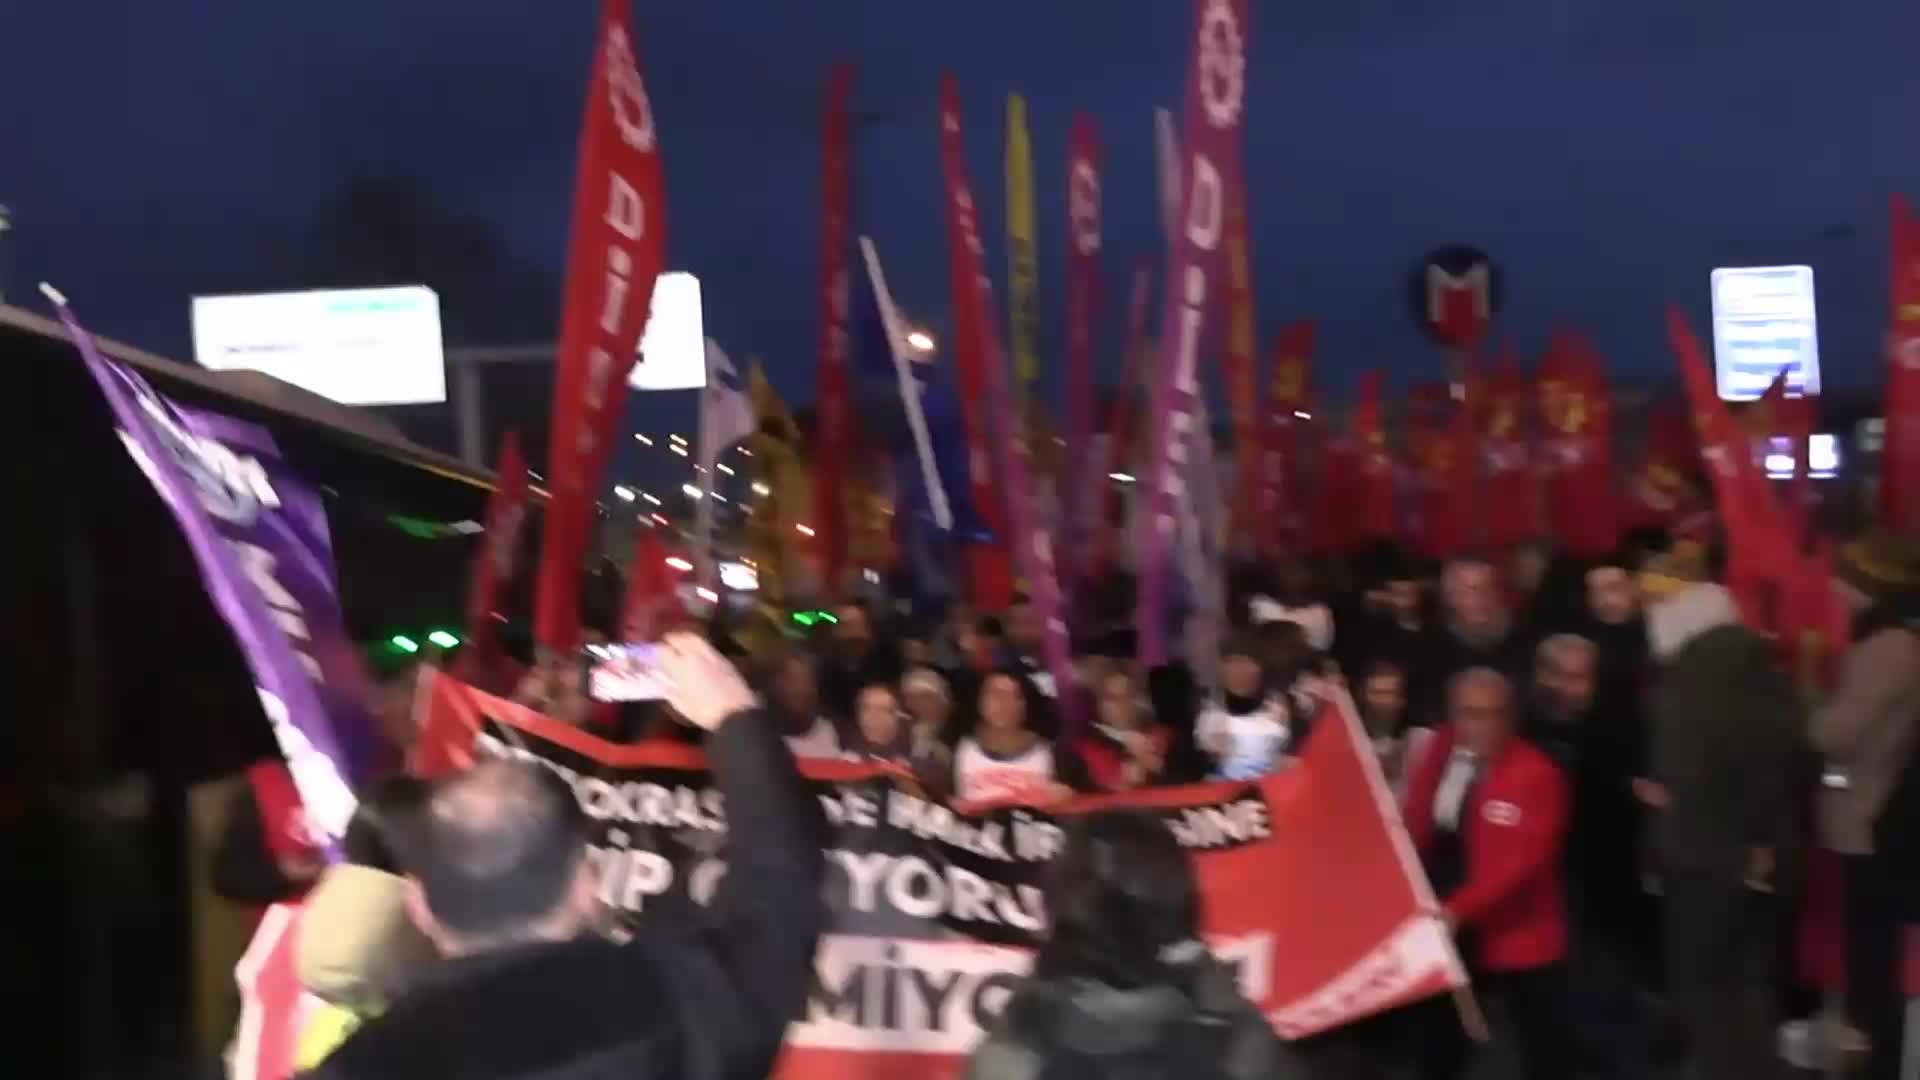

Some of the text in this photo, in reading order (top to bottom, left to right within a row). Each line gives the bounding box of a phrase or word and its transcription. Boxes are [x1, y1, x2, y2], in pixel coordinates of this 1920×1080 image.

[1427, 263, 1489, 322] M
[823, 849, 1050, 931] YORU
[800, 943, 1022, 1033] MİYO
